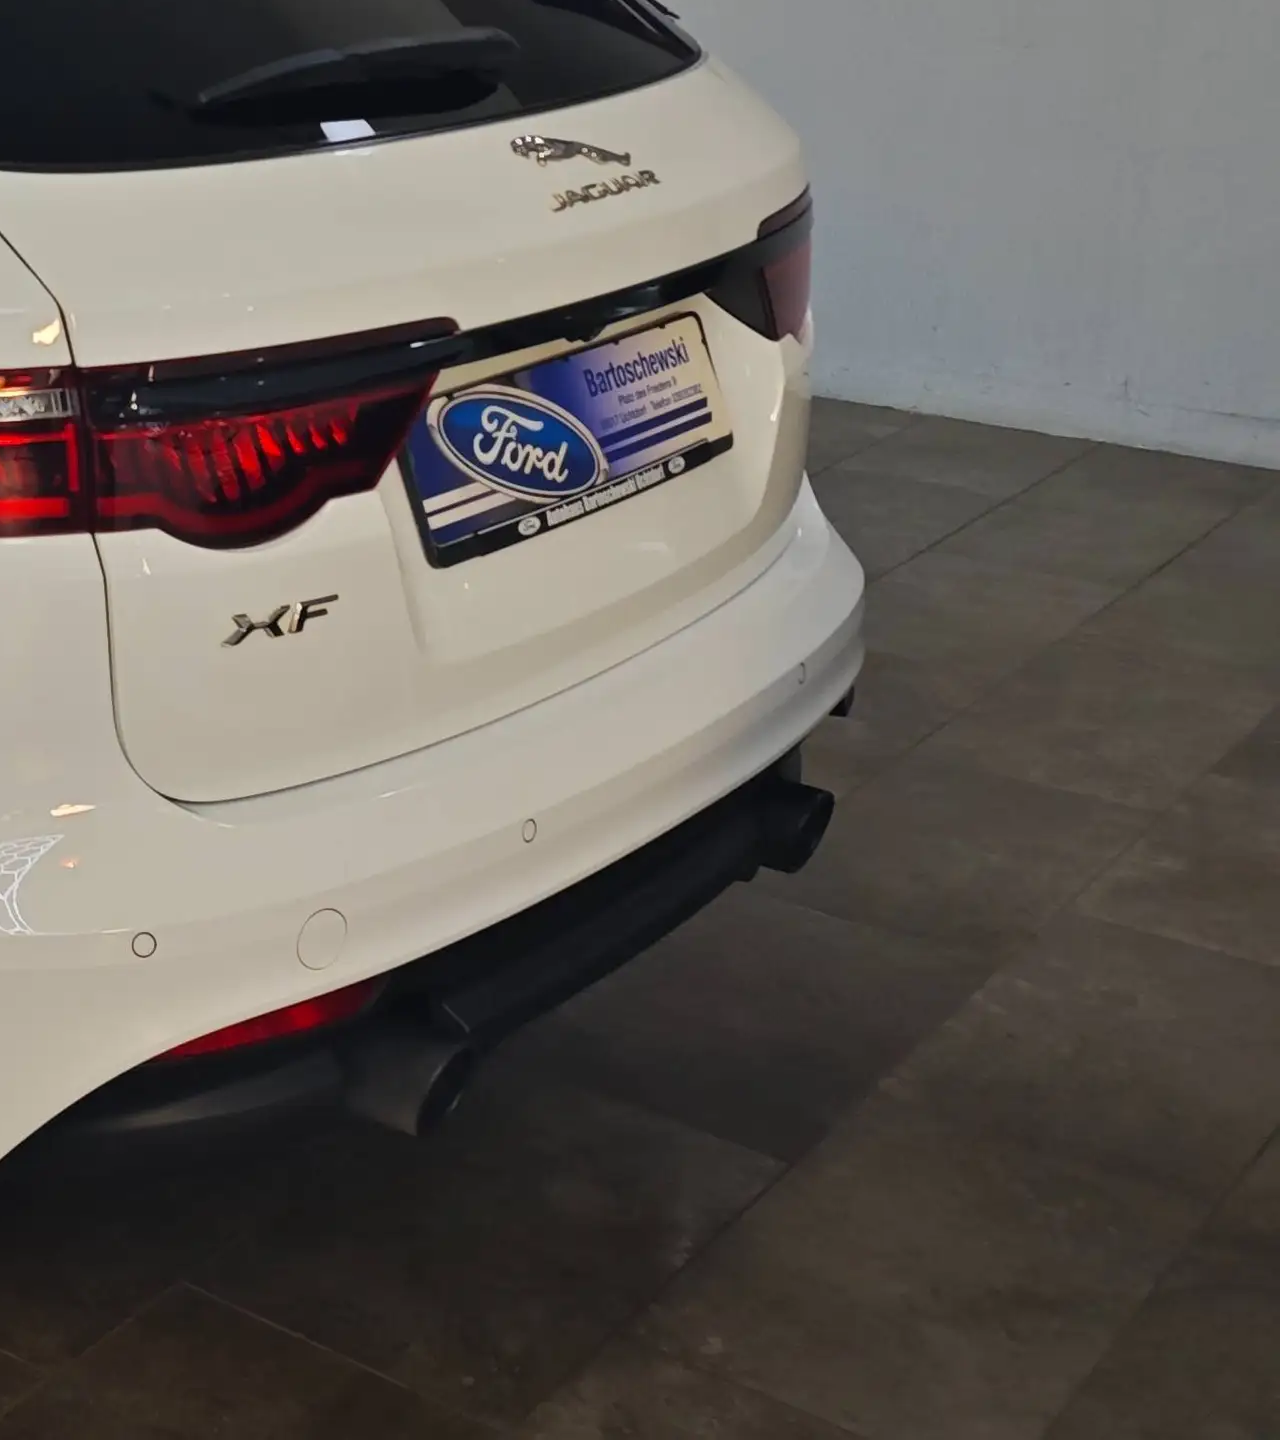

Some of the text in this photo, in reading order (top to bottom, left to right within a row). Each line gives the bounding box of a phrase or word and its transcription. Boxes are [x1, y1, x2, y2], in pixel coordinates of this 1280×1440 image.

[550, 169, 661, 212] JAGUAR
[582, 335, 691, 398] Bartoschewski
[472, 404, 570, 484] Ford
[220, 593, 339, 648] XF
